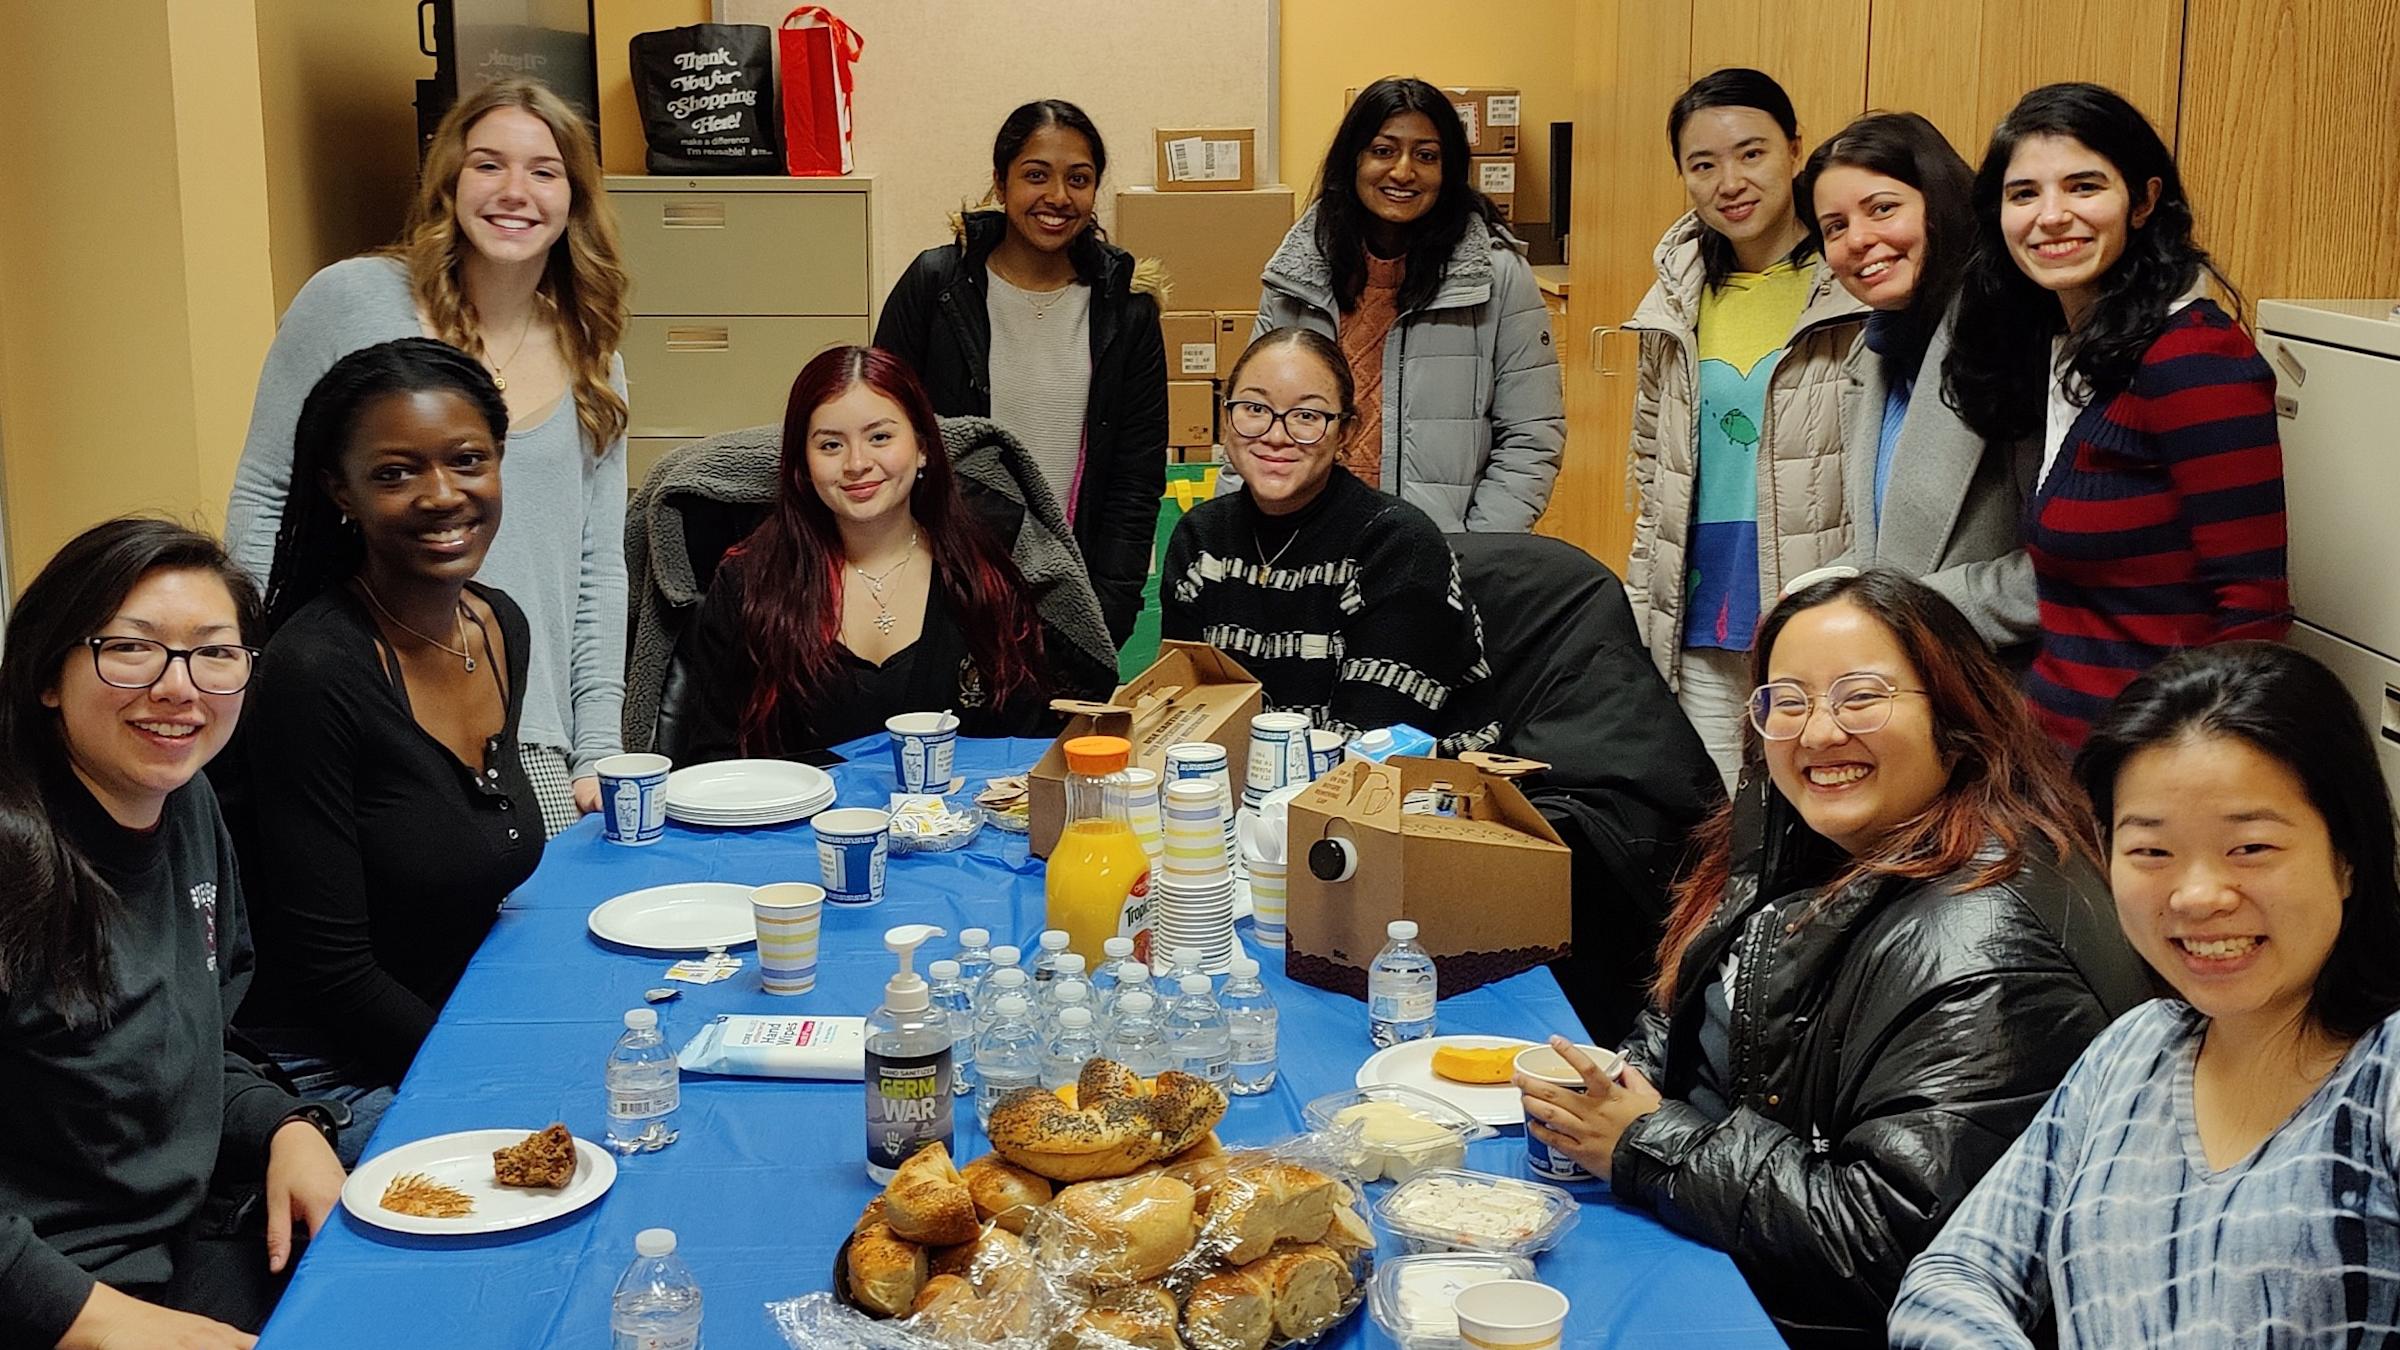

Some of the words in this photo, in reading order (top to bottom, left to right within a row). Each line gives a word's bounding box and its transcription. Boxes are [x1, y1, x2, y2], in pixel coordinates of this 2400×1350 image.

[673, 47, 738, 71] Thank
[670, 74, 711, 92] You
[704, 69, 742, 91] for
[666, 87, 758, 120] Shopping
[691, 111, 742, 135] Here!
[1124, 897, 1153, 928] Tropic
[760, 1022, 782, 1044] Hand
[775, 1022, 798, 1046] Wipes
[880, 1069, 899, 1077] HAND
[900, 1067, 936, 1077] SANITIZER
[880, 1077, 937, 1099] GERM
[881, 1096, 937, 1122] WAR
